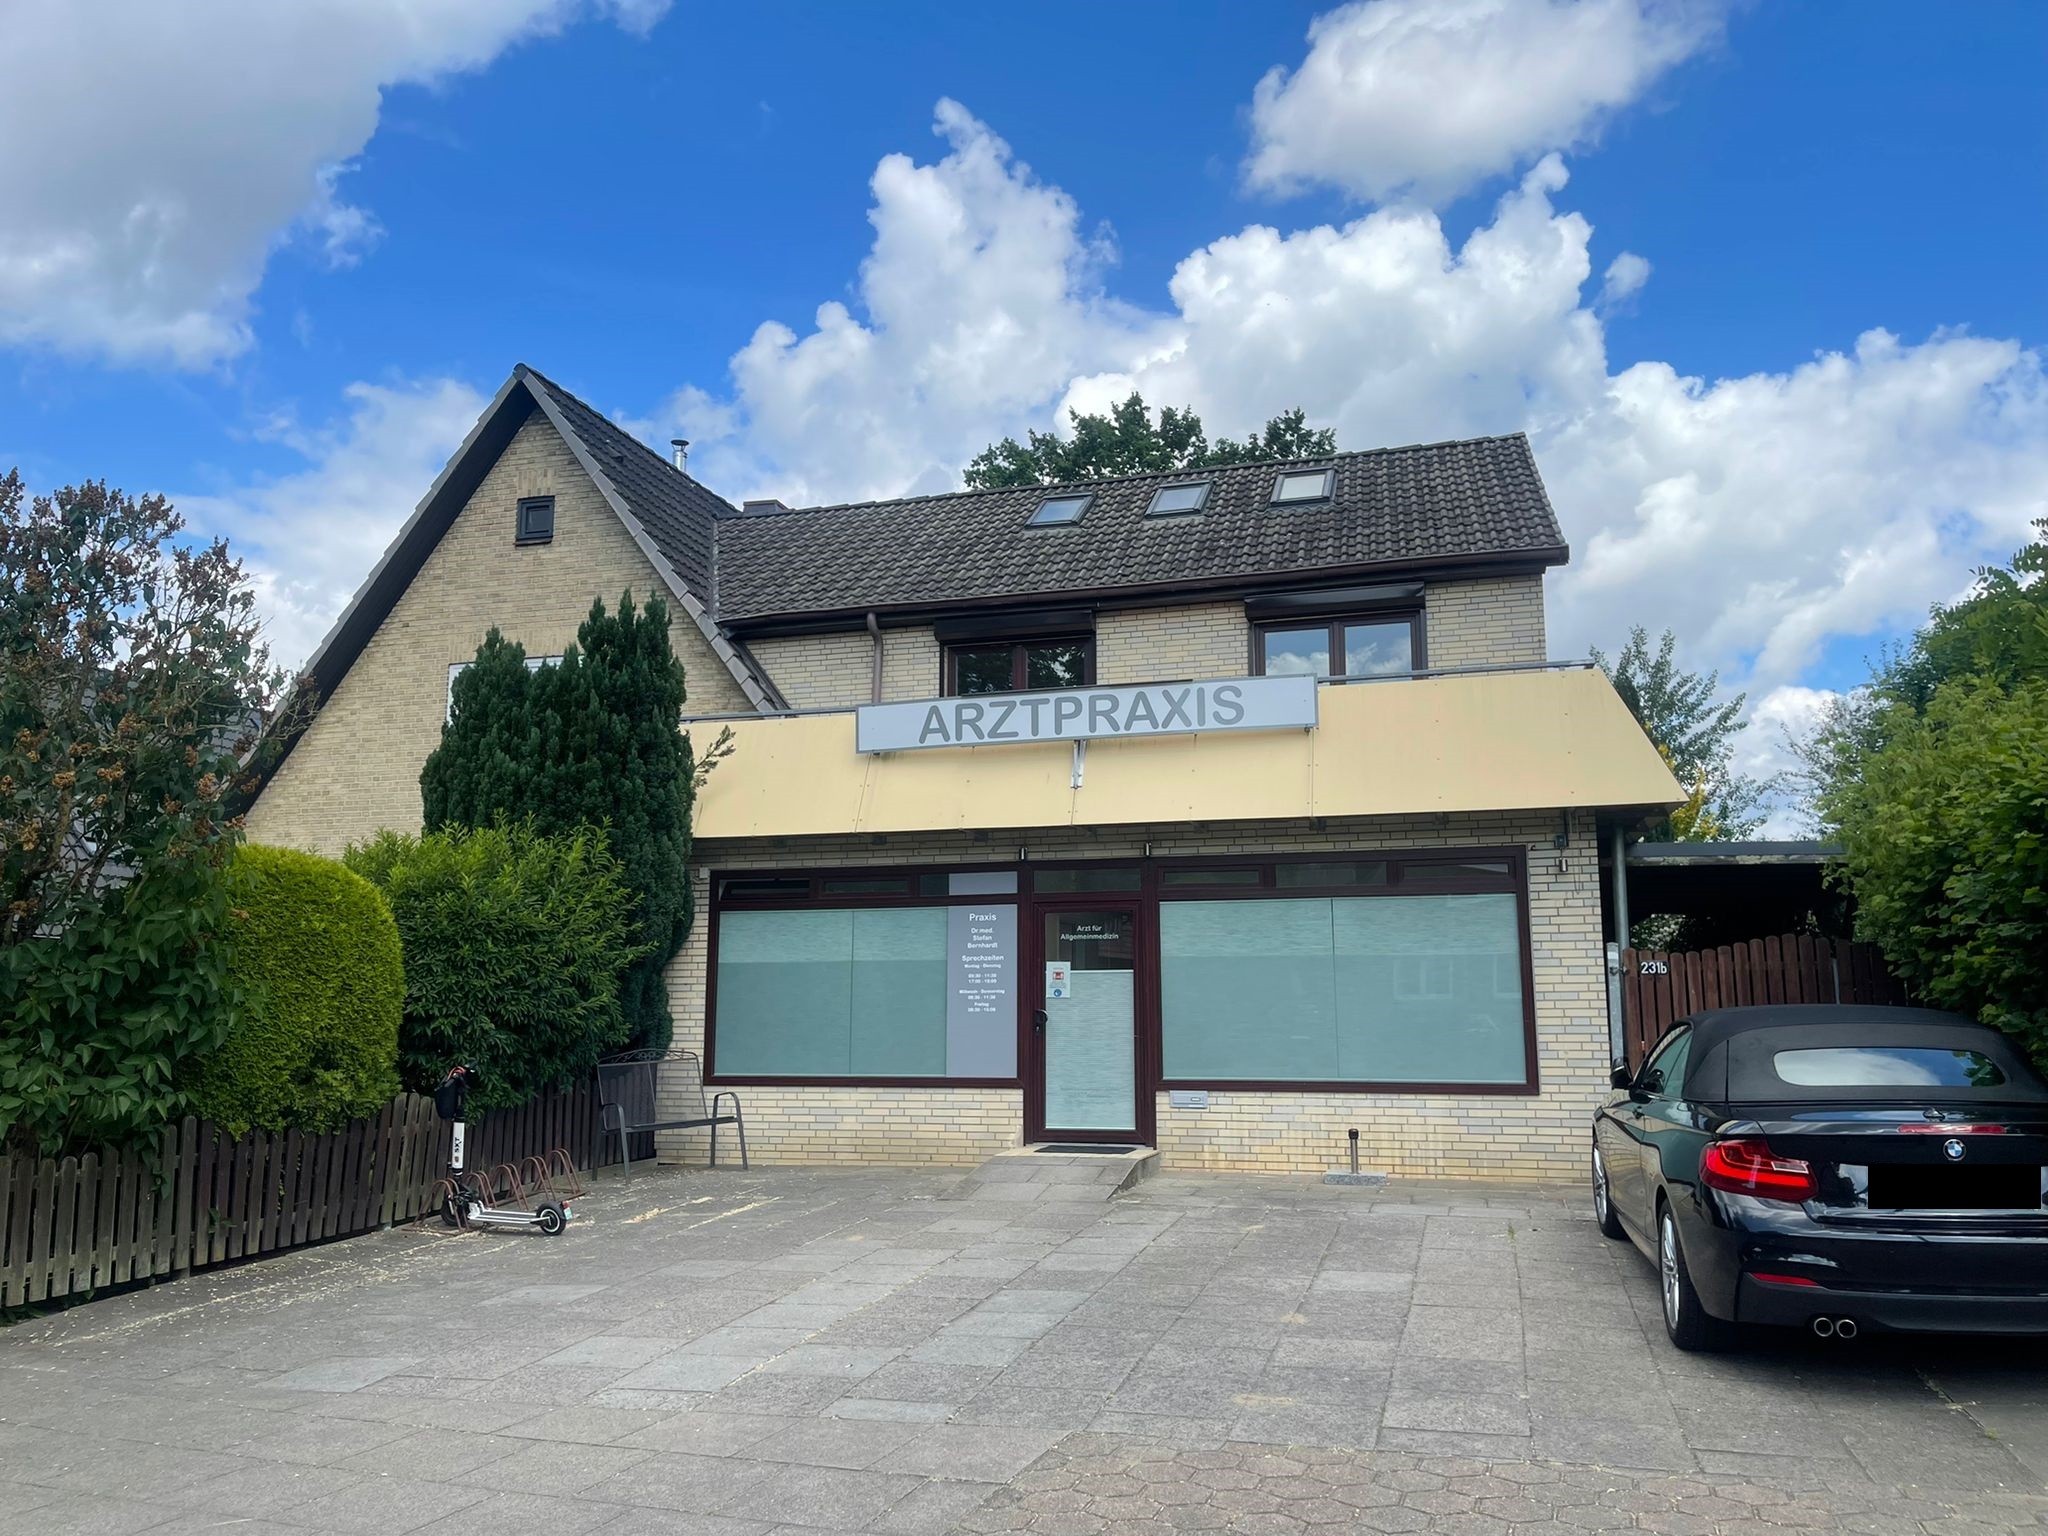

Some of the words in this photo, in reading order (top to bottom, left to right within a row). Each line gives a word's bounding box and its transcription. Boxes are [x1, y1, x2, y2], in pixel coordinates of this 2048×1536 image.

[918, 685, 1245, 745] ARZTPRAXIS
[969, 912, 997, 921] Praxis
[1060, 932, 1119, 942] Allgemeinmedizin
[961, 954, 1005, 963] Sprechzeiten
[1641, 961, 1668, 974] 231b
